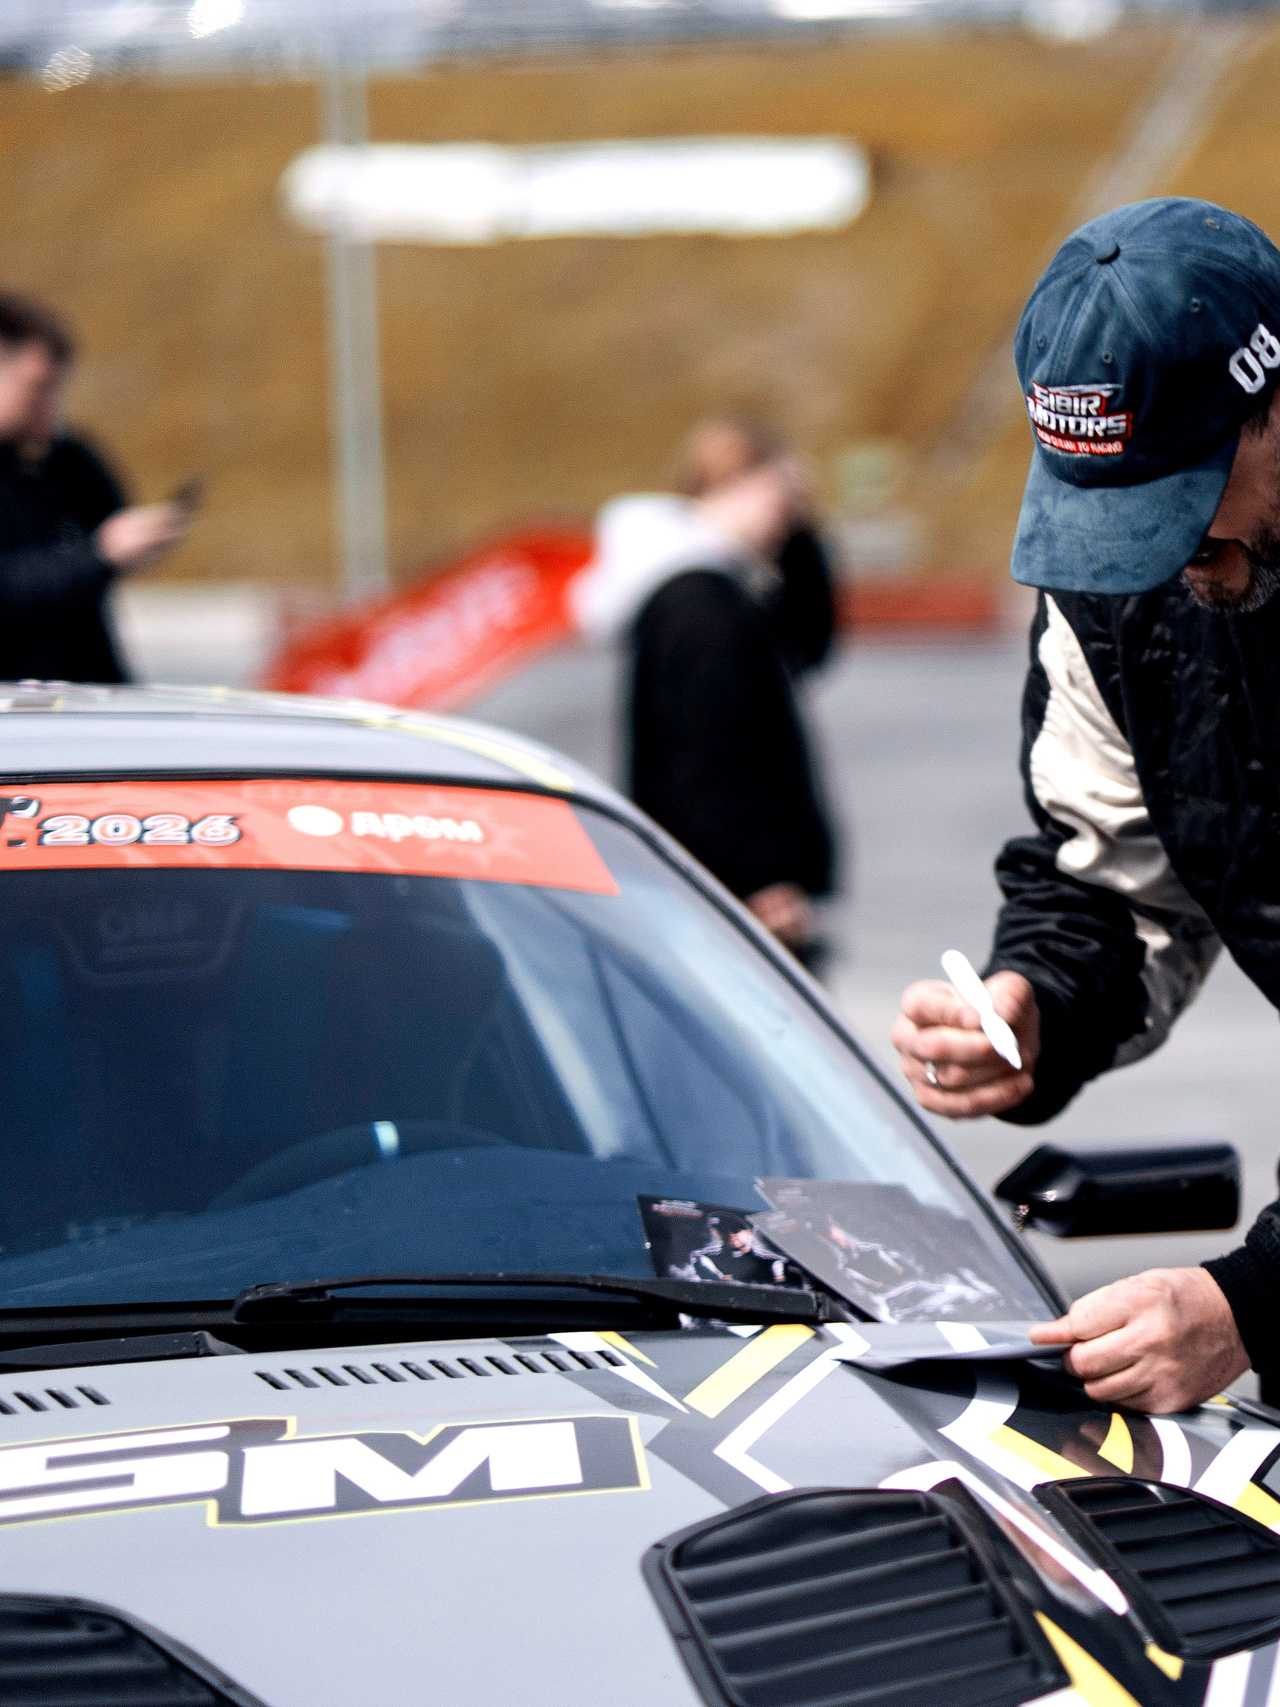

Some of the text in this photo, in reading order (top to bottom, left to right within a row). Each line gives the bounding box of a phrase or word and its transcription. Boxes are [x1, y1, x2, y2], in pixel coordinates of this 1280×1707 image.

[1027, 395, 1128, 437] MOTORS
[1032, 382, 1101, 416] SIBIR
[38, 814, 242, 846] 2026
